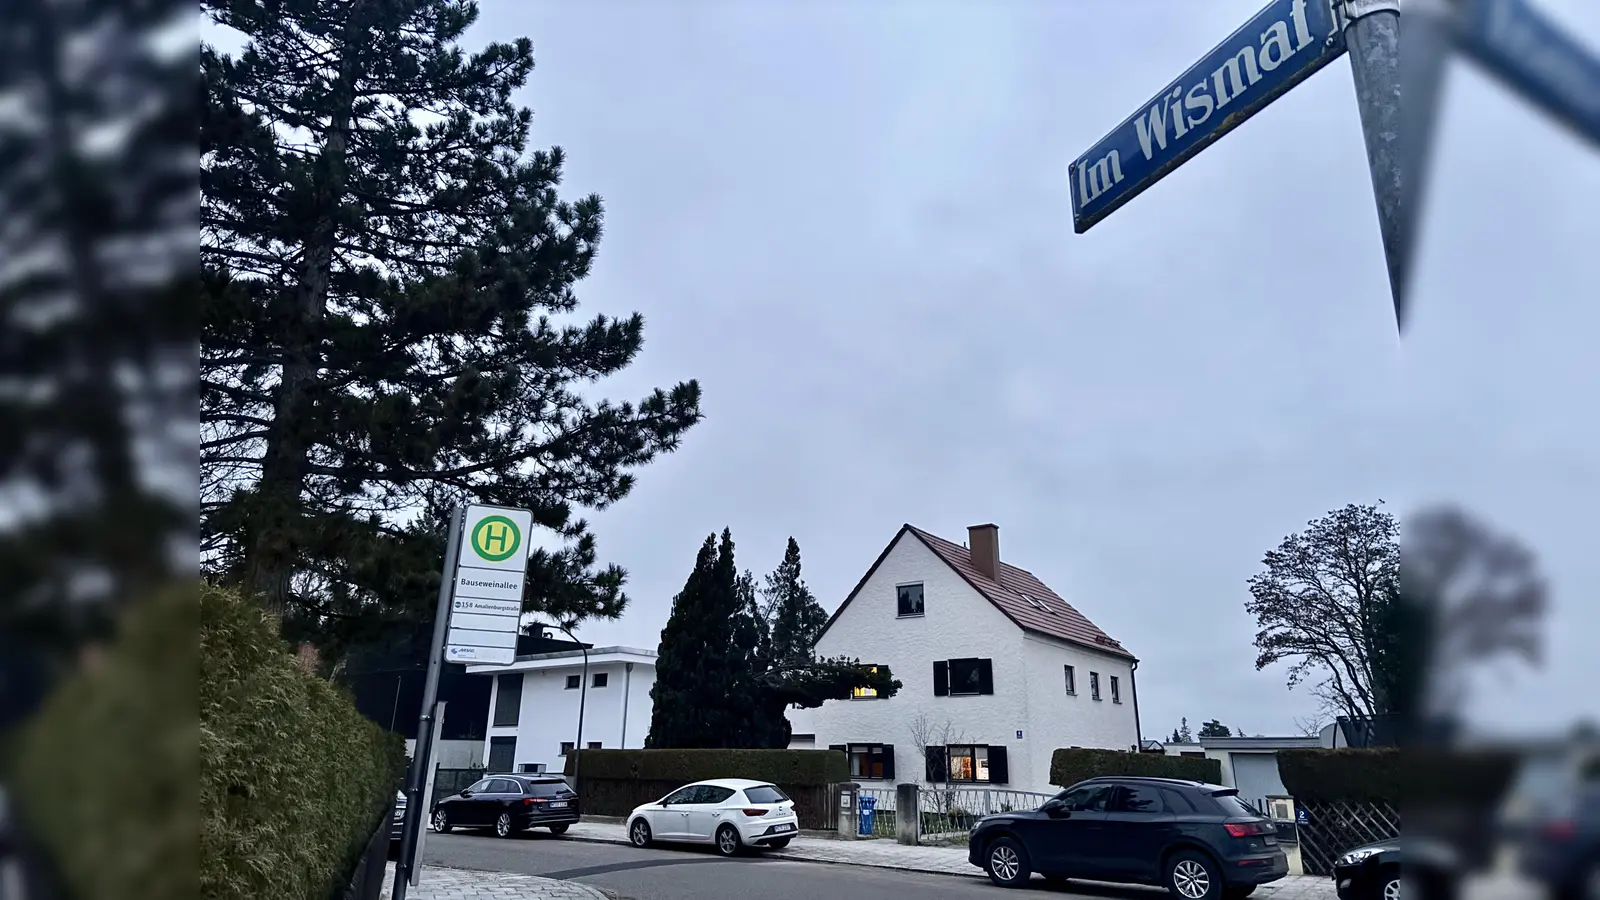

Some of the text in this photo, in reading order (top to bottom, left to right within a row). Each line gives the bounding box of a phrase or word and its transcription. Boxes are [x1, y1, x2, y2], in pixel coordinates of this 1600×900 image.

[1078, 149, 1124, 208] Im
[485, 525, 507, 552] H
[460, 578, 518, 590] Bauseweinallee
[461, 601, 473, 609] 158
[474, 603, 520, 612] Amalienburgstraße
[1299, 810, 1305, 818] 2
